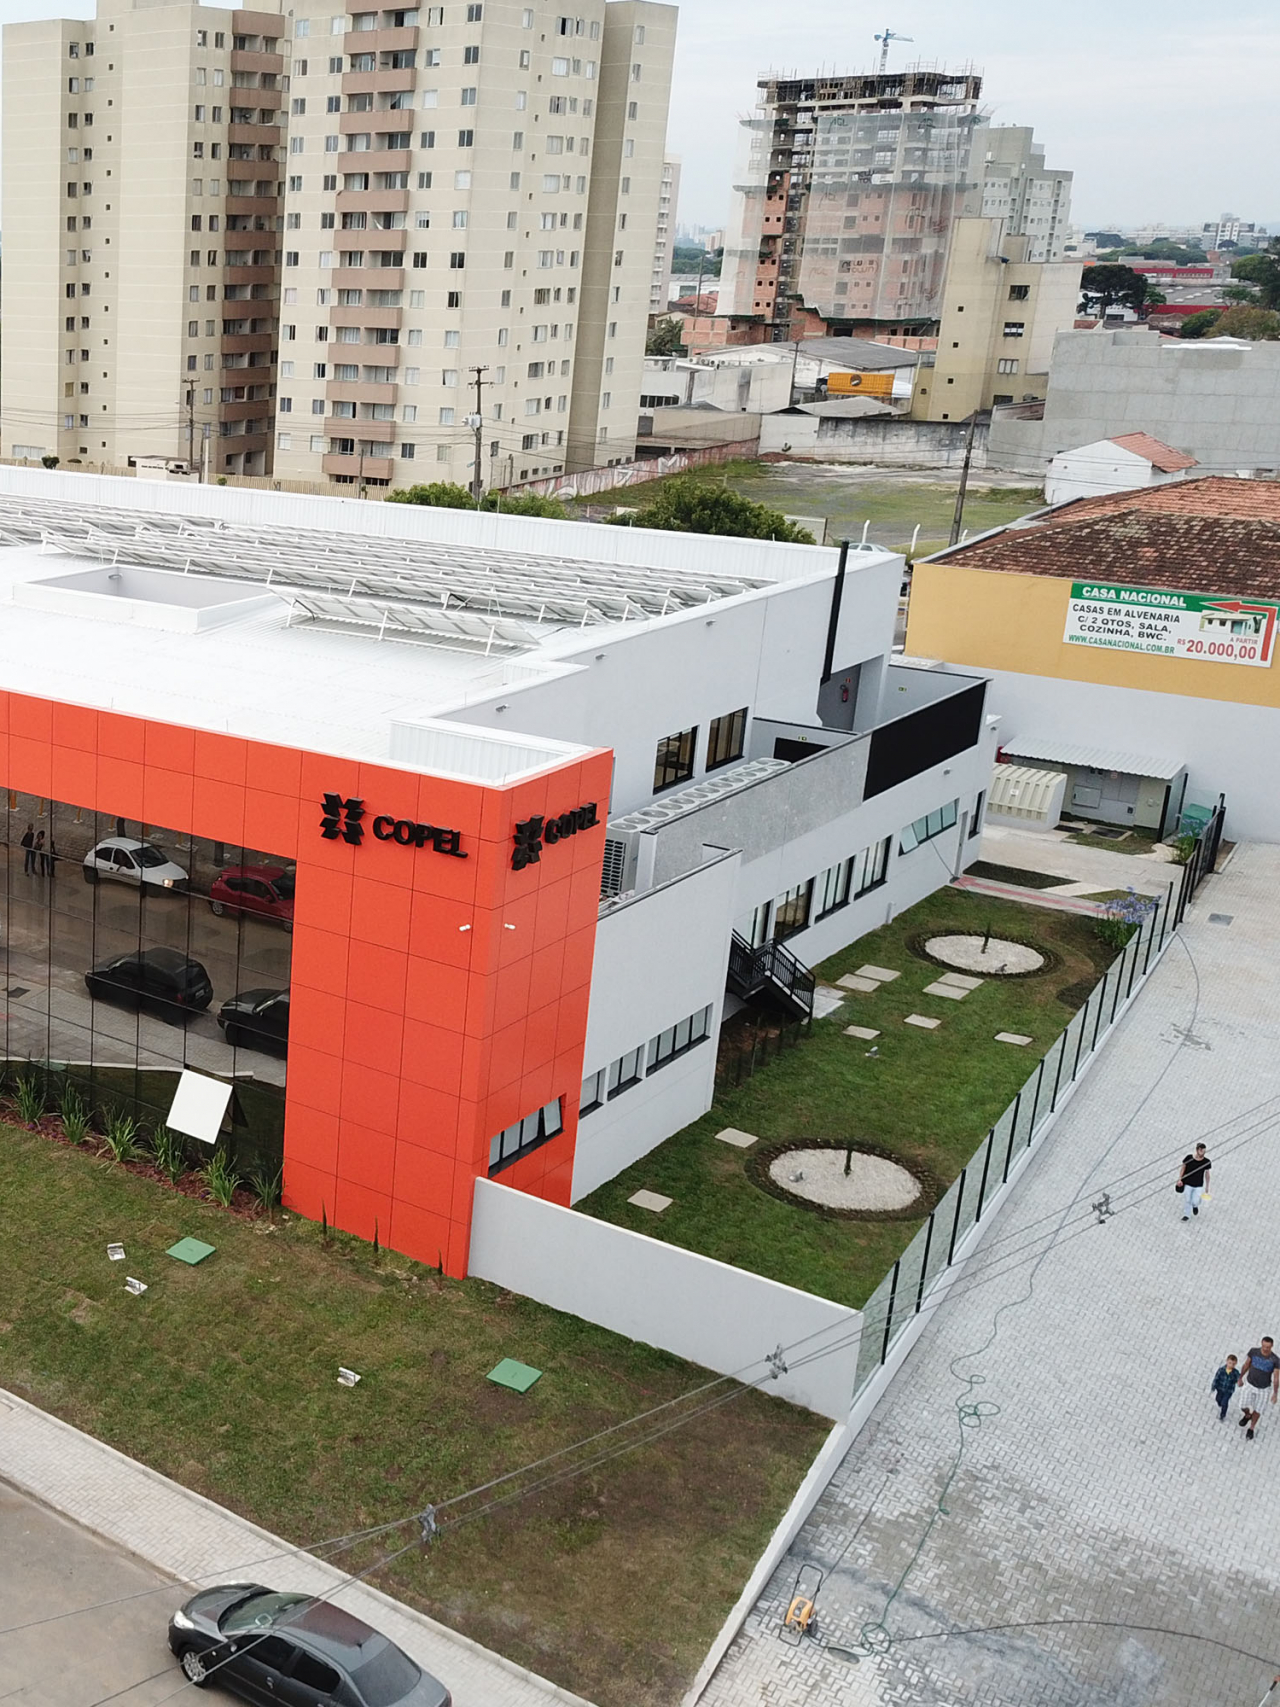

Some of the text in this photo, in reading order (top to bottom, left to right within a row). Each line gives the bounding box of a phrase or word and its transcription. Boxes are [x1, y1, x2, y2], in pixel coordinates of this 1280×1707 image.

[1082, 587, 1187, 607] CASA NACIONAL
[1072, 603, 1180, 623] CASAS EM ALVENARIA
[1077, 615, 1172, 634] C/ 2 QTOS, SALA,
[1079, 624, 1167, 641] COZINHA, BWC.
[1068, 634, 1175, 654] WWW.CASANACIONAL.COM.BR
[1186, 639, 1257, 660] 20.000,00
[1235, 637, 1259, 645] PARTIR
[372, 814, 468, 859] COPEL
